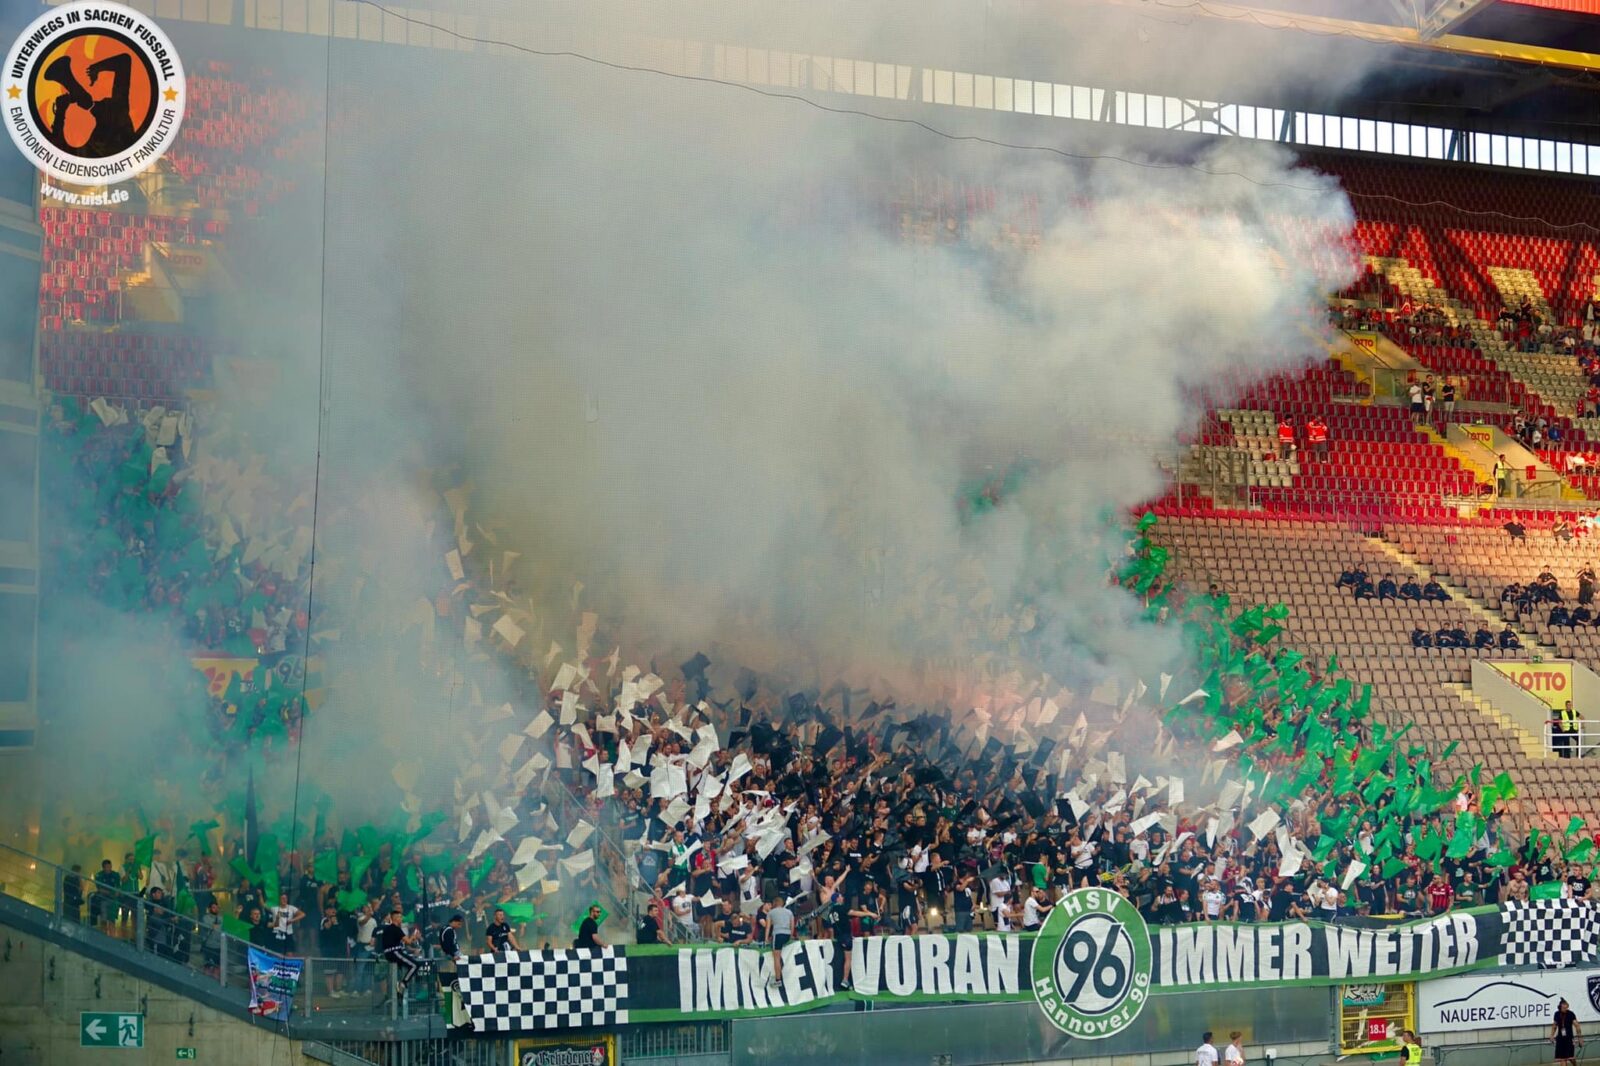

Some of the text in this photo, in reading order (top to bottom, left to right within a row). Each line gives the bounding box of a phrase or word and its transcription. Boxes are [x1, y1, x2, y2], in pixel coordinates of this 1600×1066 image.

[1063, 891, 1120, 917] HSV
[678, 933, 1020, 1013] IMMER VORAN
[1063, 924, 1126, 1003] 96
[1159, 912, 1479, 986] IMMER WEITER
[1035, 972, 1149, 1034] Hannover 96
[1369, 1024, 1385, 1034] 18.1
[1440, 1003, 1551, 1024] NAUERZ-GRUPPE
